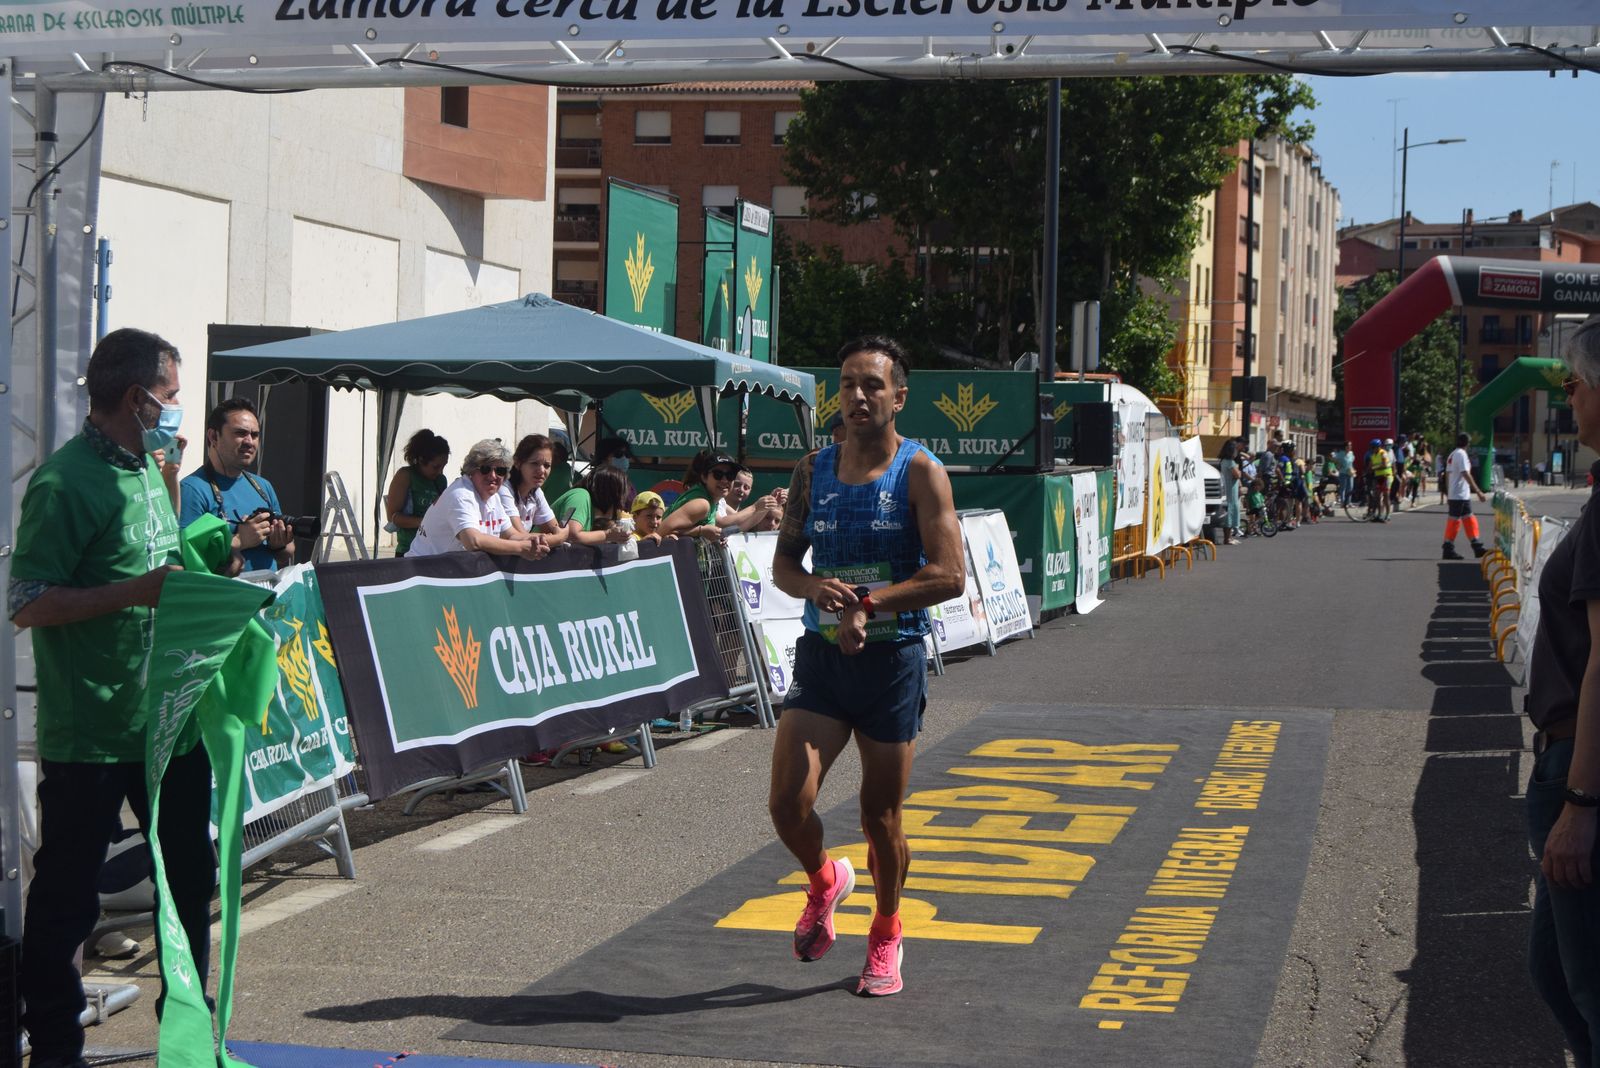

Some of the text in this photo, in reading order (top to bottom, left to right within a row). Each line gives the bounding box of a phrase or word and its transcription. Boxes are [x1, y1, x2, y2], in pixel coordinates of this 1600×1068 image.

[43, 12, 65, 31] DE
[73, 8, 164, 30] ESCLEROSIS
[171, 2, 245, 26] MÚLTIPLE
[1494, 284, 1537, 295] ZAMORA
[1554, 272, 1600, 286] CON E
[758, 432, 804, 449] CAJA
[912, 437, 1025, 455] AJA RURAL
[834, 566, 880, 578] FUNDACION
[985, 588, 1027, 626] OCEANIC
[489, 609, 657, 696] CAJA RURAL
[1213, 720, 1282, 769] INTERIORES
[1078, 825, 1250, 1013] REFORMA INTEGRAL
